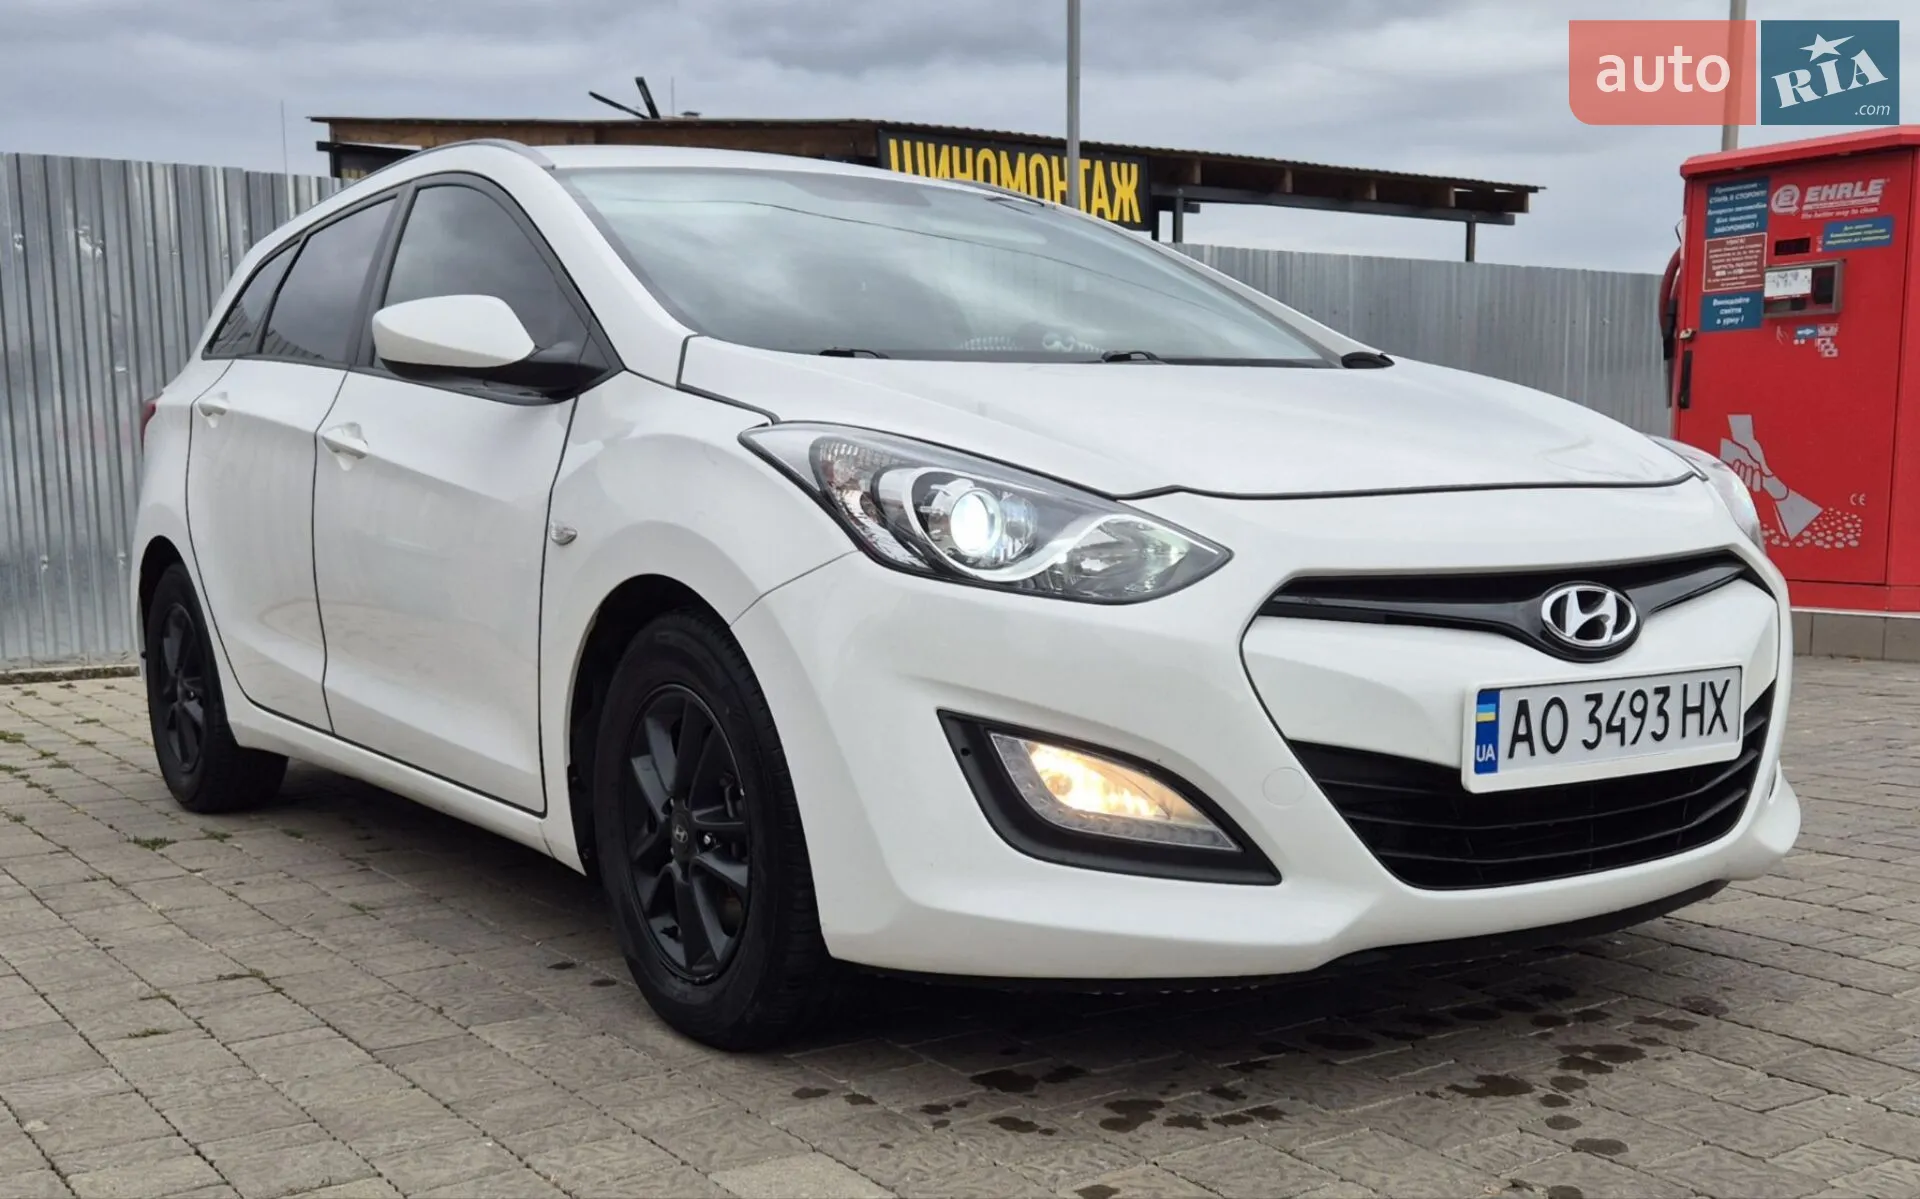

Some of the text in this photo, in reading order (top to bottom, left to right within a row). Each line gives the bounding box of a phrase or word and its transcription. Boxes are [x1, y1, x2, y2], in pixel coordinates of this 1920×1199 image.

[1804, 179, 1885, 203] EHRLE
[1581, 685, 1671, 750] 3493
[1476, 744, 1496, 763] UA
